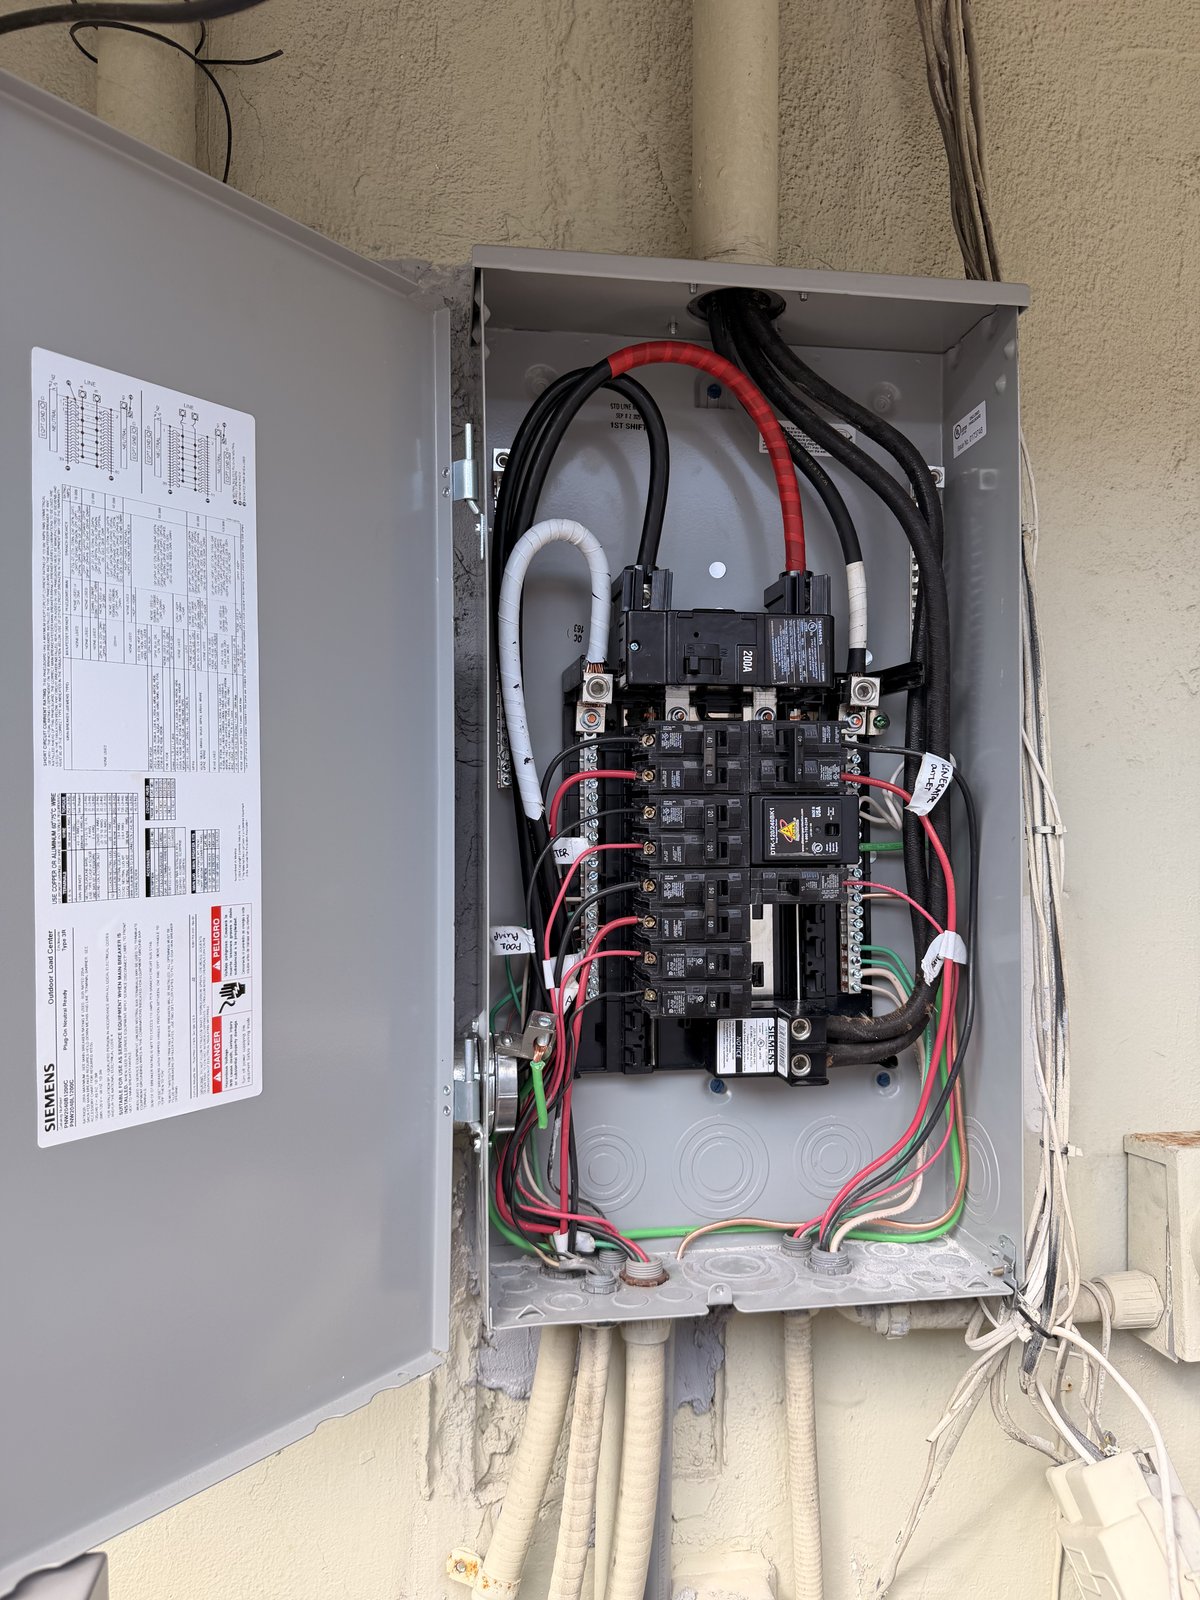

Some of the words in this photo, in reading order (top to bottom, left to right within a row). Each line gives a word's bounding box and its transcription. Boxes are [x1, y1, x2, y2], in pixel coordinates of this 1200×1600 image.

[626, 423, 646, 431] SHIFT
[743, 650, 753, 672] 200A
[52, 860, 57, 868] OR
[500, 942, 522, 951] POOL
[213, 1030, 221, 1069] DANGER
[118, 1056, 122, 1064] AS
[44, 1063, 56, 1132] SIEMENS
